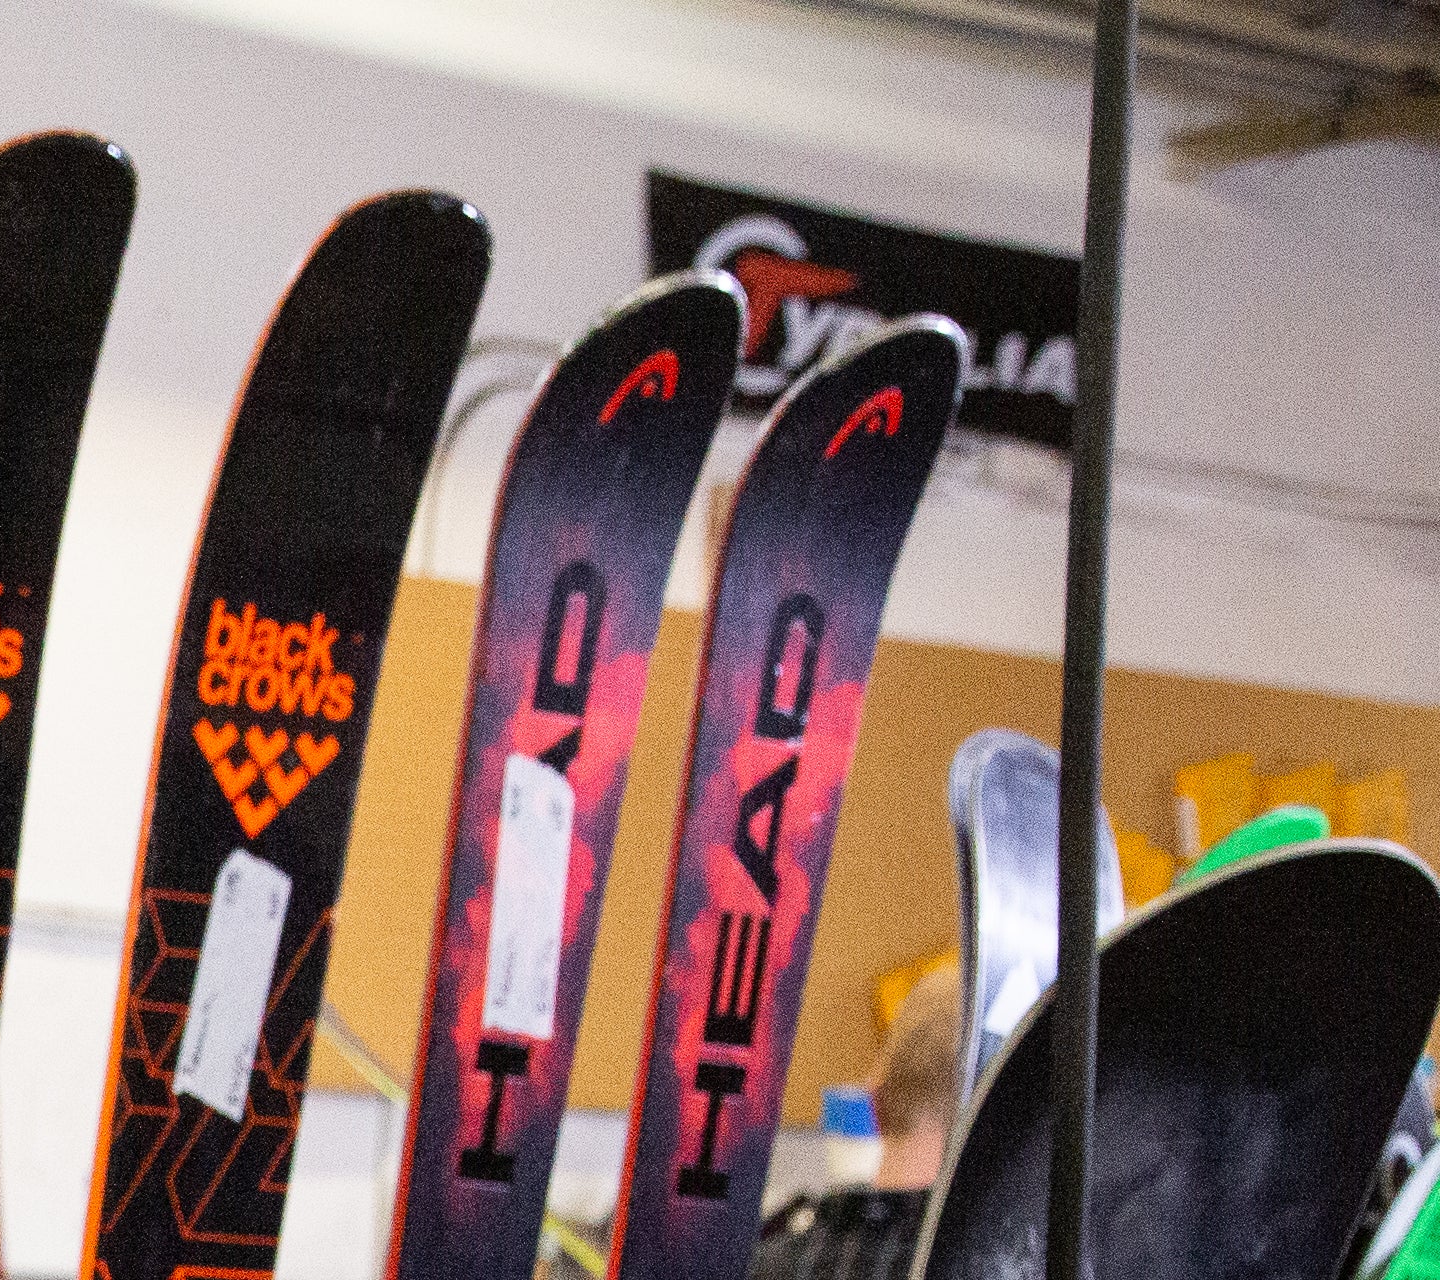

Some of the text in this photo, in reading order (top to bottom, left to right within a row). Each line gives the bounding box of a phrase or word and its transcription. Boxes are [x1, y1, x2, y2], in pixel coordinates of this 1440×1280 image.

[197, 658, 356, 722] crows
[204, 597, 340, 674] black
[456, 558, 608, 1184] HD
[679, 593, 826, 1199] HEAD
